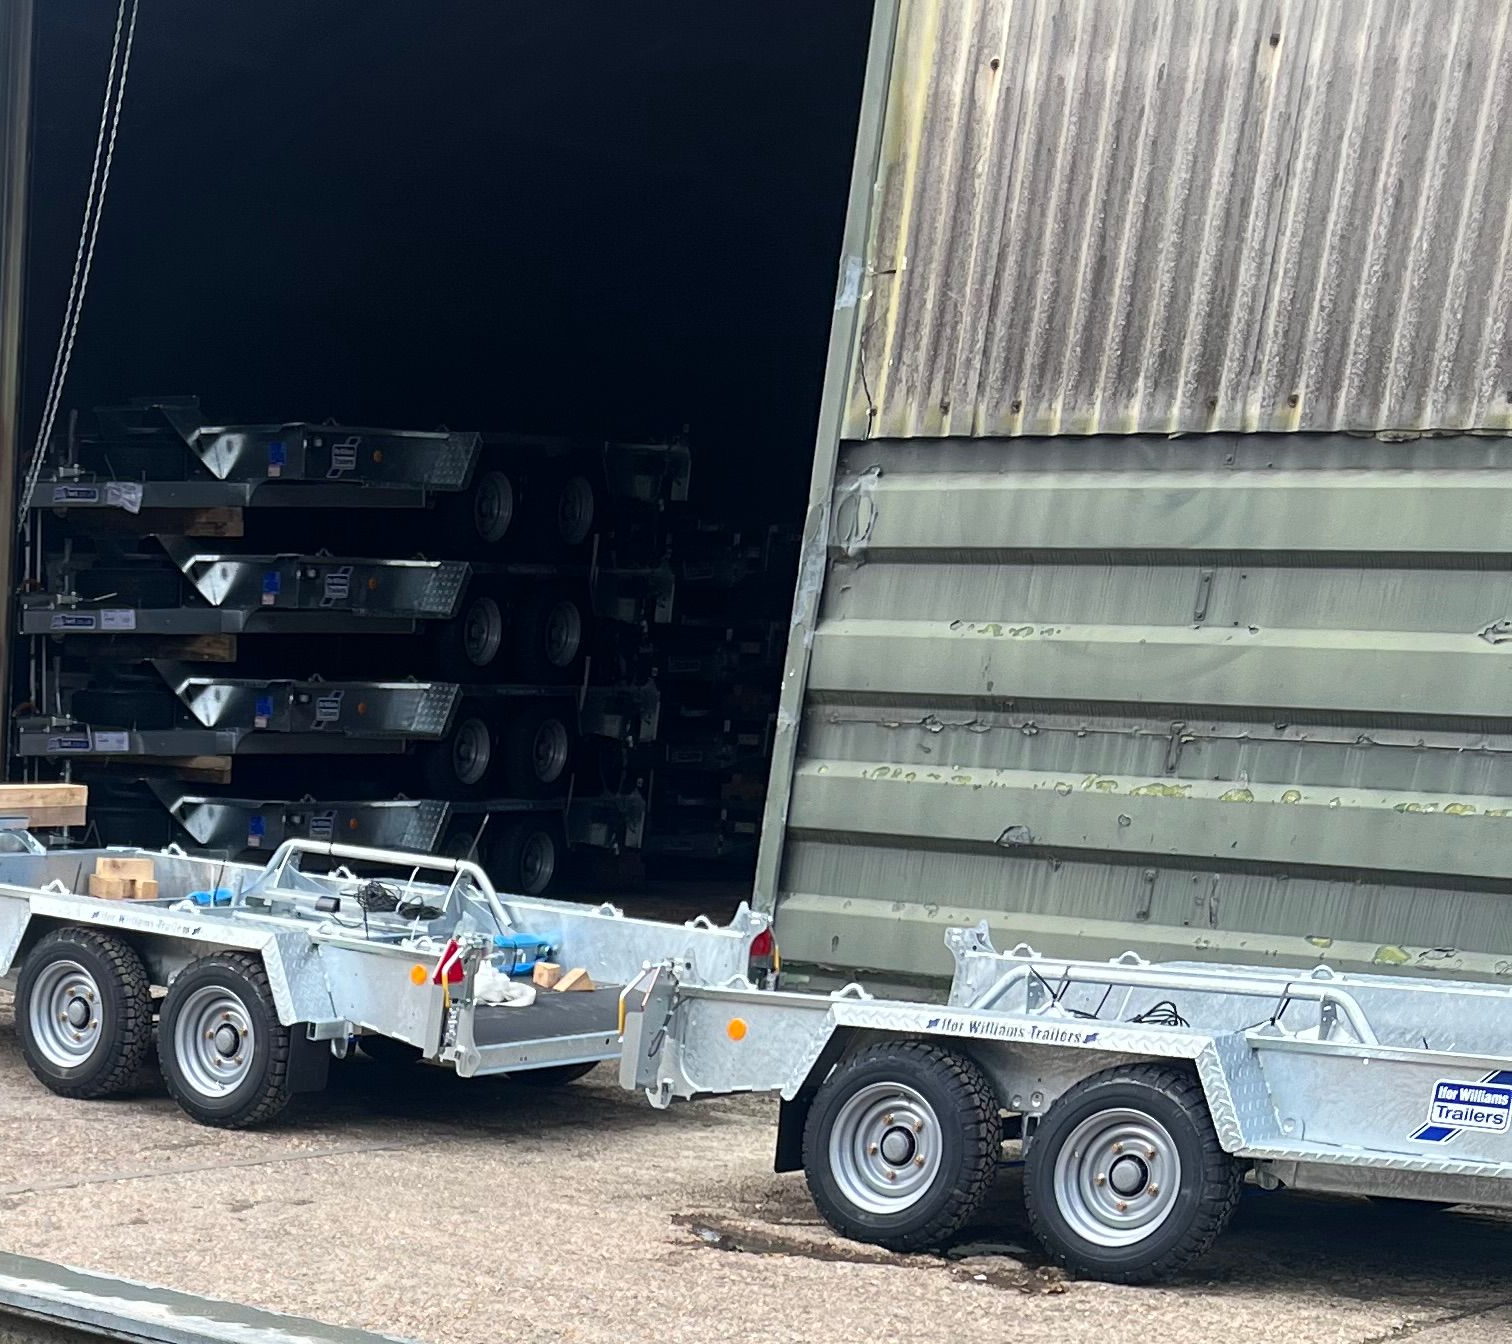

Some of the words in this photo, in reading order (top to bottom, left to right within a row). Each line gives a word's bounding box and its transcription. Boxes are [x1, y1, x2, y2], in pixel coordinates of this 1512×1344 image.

[941, 1017, 964, 1031] Ifor
[969, 1020, 1025, 1038] Williams
[1031, 1025, 1082, 1044] Trailers
[1437, 1085, 1458, 1100] Ifor
[1459, 1088, 1510, 1106] Williams
[1436, 1105, 1504, 1125] Trailers
